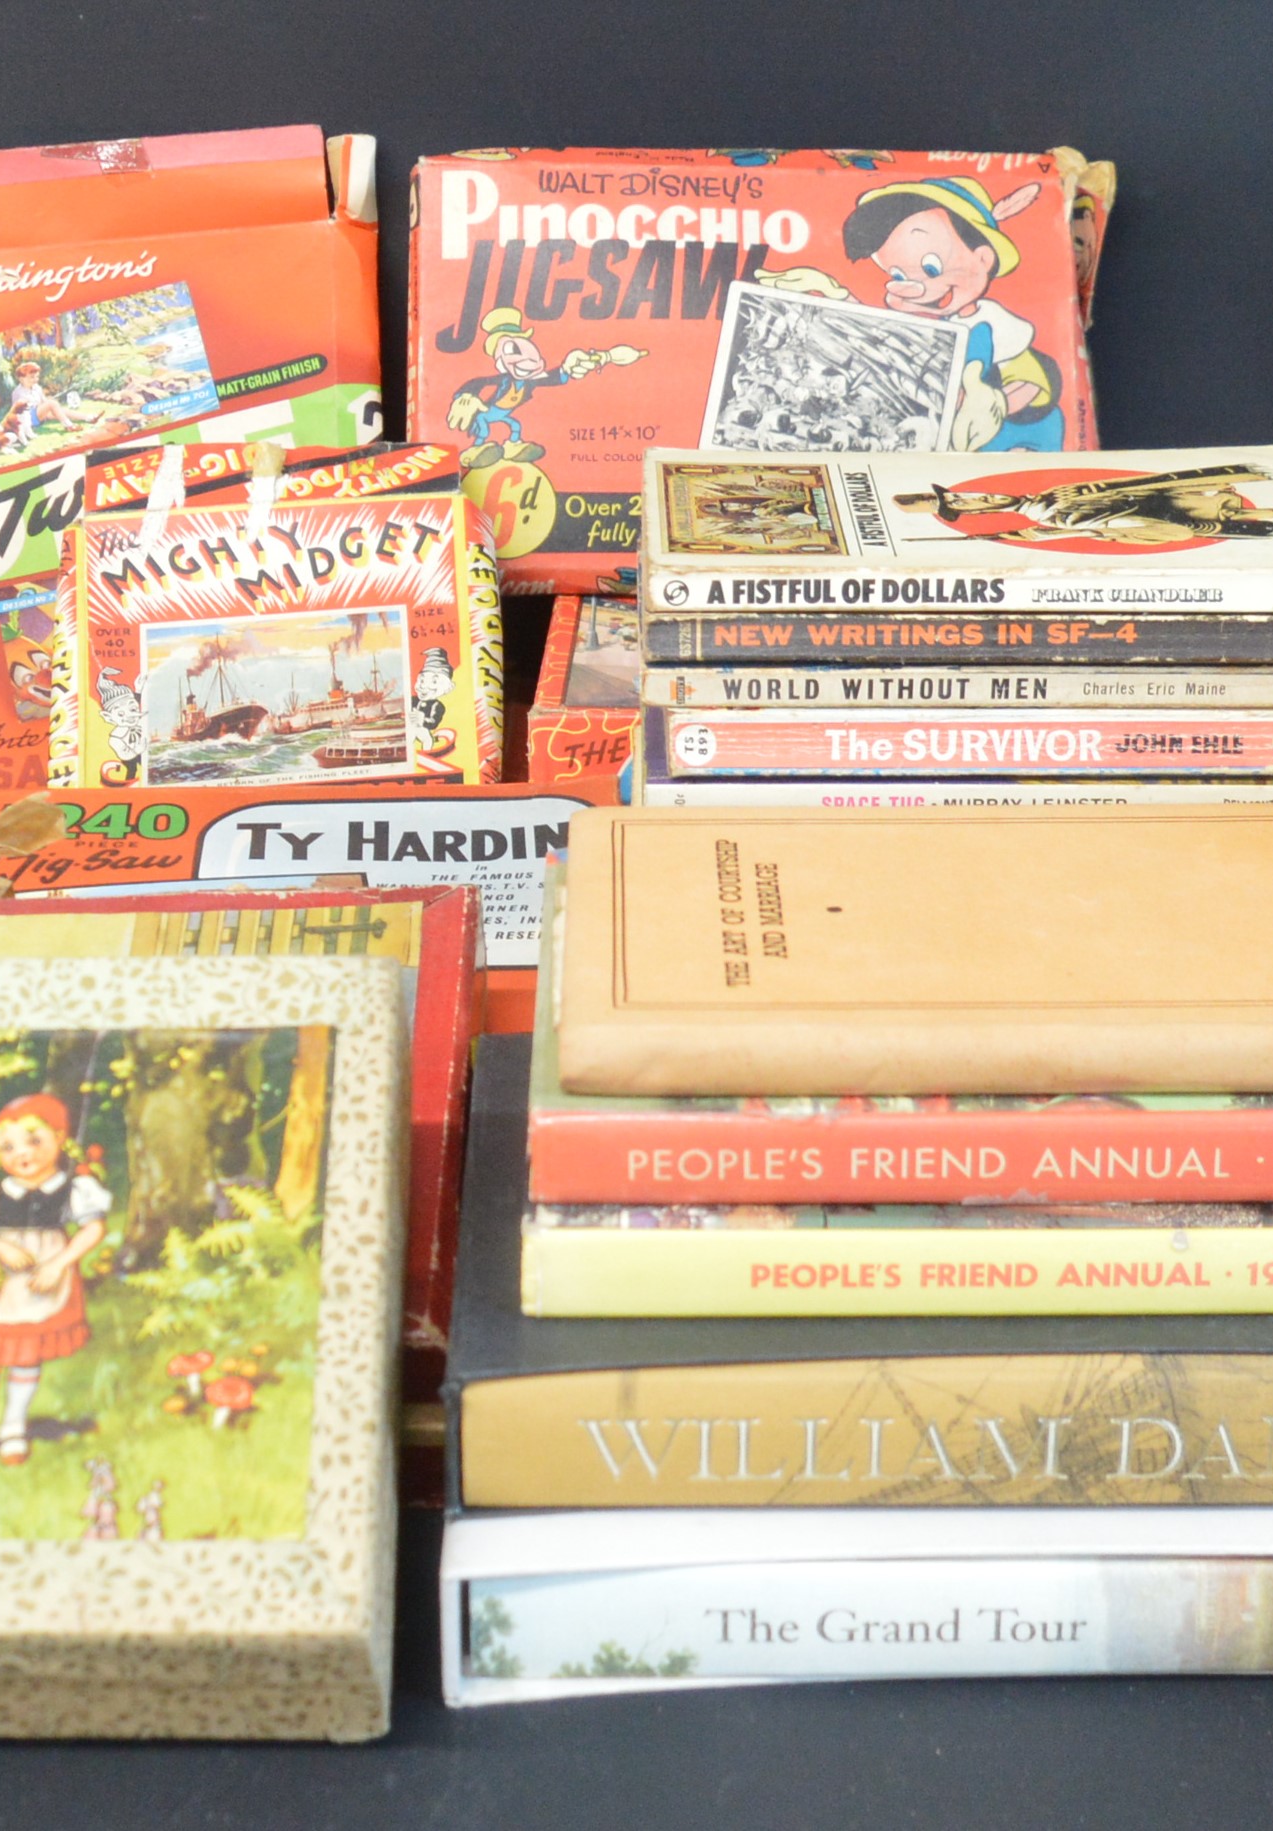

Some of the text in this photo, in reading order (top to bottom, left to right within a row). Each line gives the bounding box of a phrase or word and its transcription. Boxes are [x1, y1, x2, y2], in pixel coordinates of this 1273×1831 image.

[539, 166, 764, 206] WALT DISNEY'S
[435, 239, 770, 354] JIGSAW
[216, 357, 321, 398] MATT-GRAIN FINISH
[569, 428, 595, 441] SIZE
[334, 445, 450, 497] MIGHTY
[570, 453, 643, 463] FULL COLOU
[564, 497, 622, 518] Over
[95, 527, 141, 559] The
[587, 521, 636, 548] fully
[234, 521, 441, 609] MIDGET
[706, 579, 726, 604] A
[732, 578, 836, 604] FISTFUL
[841, 578, 876, 604] OF
[881, 577, 1006, 604] DOLLARS
[1031, 588, 1104, 603] FRANK
[1107, 588, 1224, 603] CHANDLER
[414, 607, 444, 618] SIZE
[95, 627, 132, 637] OVER
[104, 638, 125, 648] 40
[713, 624, 794, 646] NEW
[806, 623, 984, 646] WRITINGS
[997, 623, 1033, 645] IN
[94, 649, 136, 658] PIECES
[722, 677, 1226, 700] WORLD WITHOUT MEN Charles Eric Maine
[564, 736, 628, 769] THE
[684, 735, 695, 755] TS
[825, 728, 1244, 762] The SURVIVOR JOHN EHLE
[56, 802, 190, 840] 240
[346, 820, 570, 863] HARDIN
[469, 872, 534, 881] FAMOUS
[475, 864, 488, 872] in
[715, 838, 751, 987] THE ART OF COURTSHIP
[754, 862, 788, 959] AND MARRIAGE
[627, 1147, 824, 1182] PEOPLE'S
[850, 1146, 1007, 1180] FRIEND
[1032, 1146, 1230, 1180] ANNUAL
[749, 1262, 902, 1289] PEOPLE'S
[918, 1262, 1040, 1289] FRIEND
[1055, 1261, 1211, 1288] ANNUAL
[576, 1416, 1073, 1483] WILLIAM
[704, 1606, 1088, 1644] The Grand Tour
